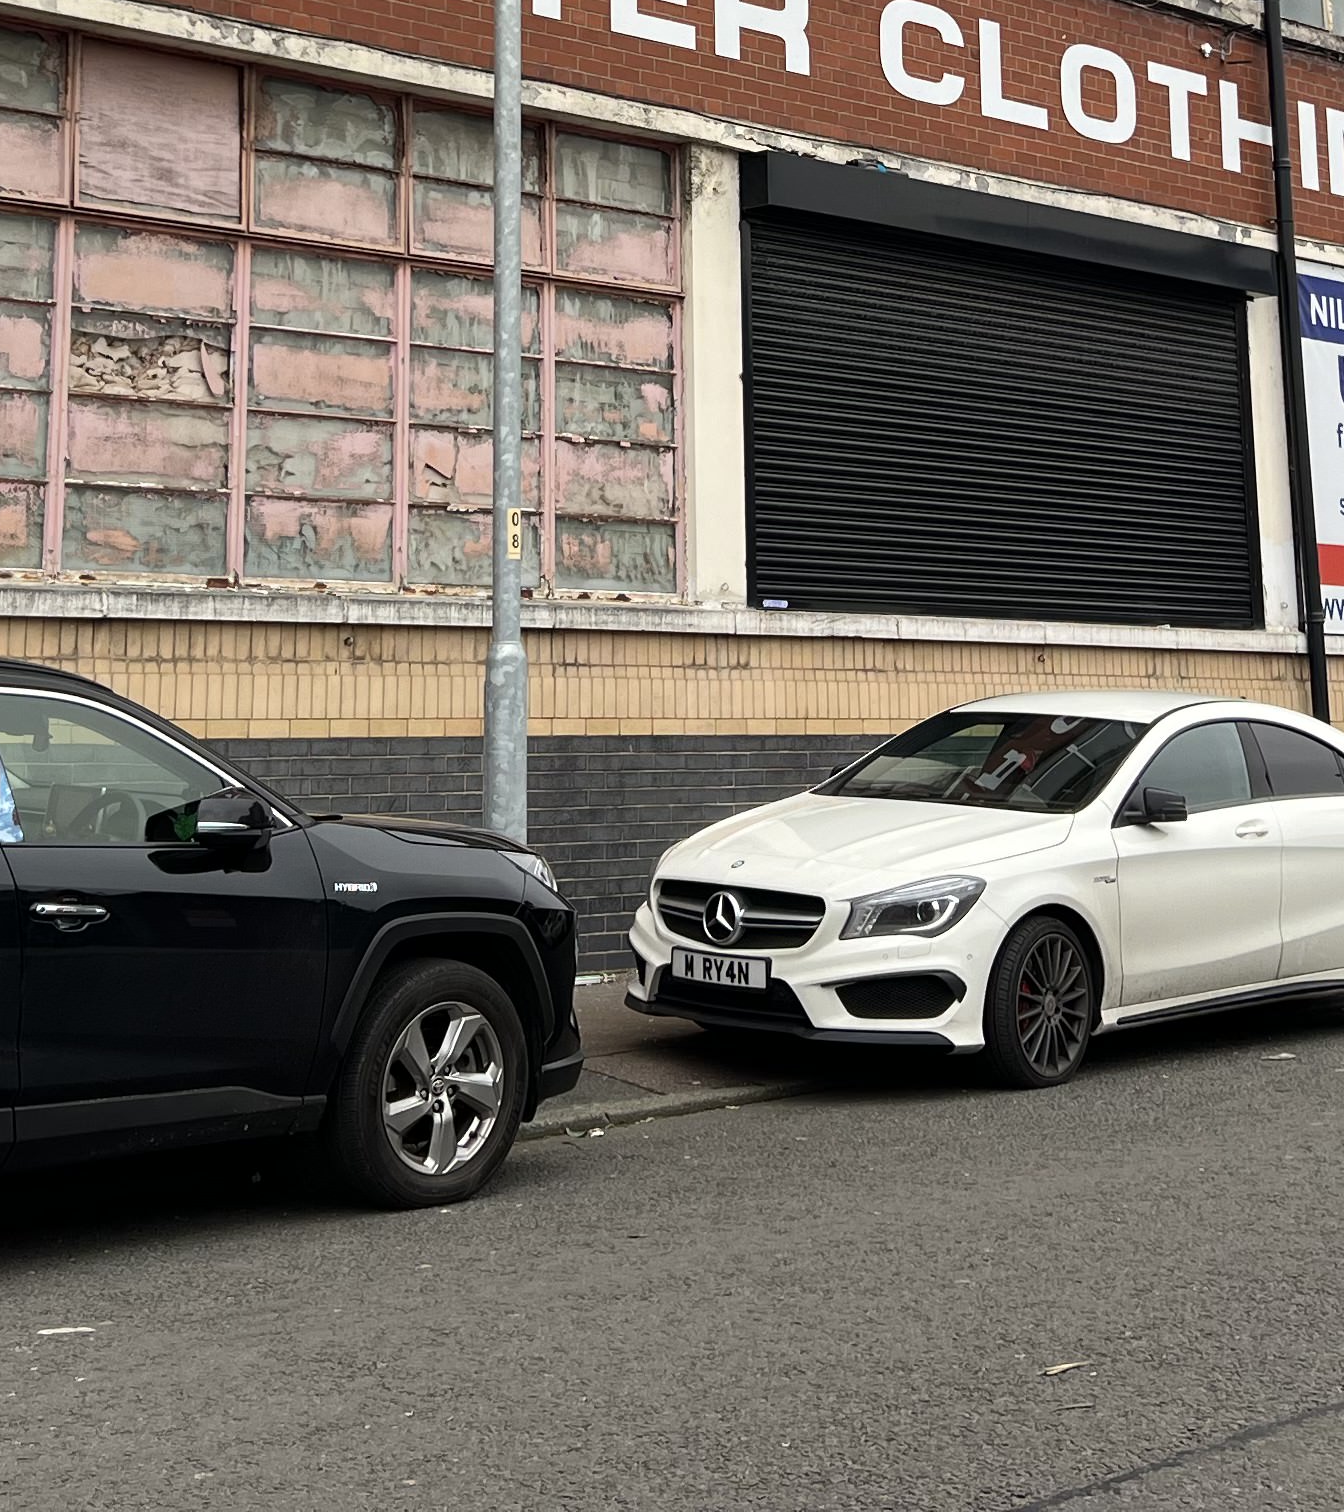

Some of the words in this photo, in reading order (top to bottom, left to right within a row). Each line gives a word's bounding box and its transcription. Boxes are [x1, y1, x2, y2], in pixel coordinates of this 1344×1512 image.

[334, 882, 370, 892] HYBRID
[684, 954, 694, 978] M
[702, 956, 750, 986] RY4N
